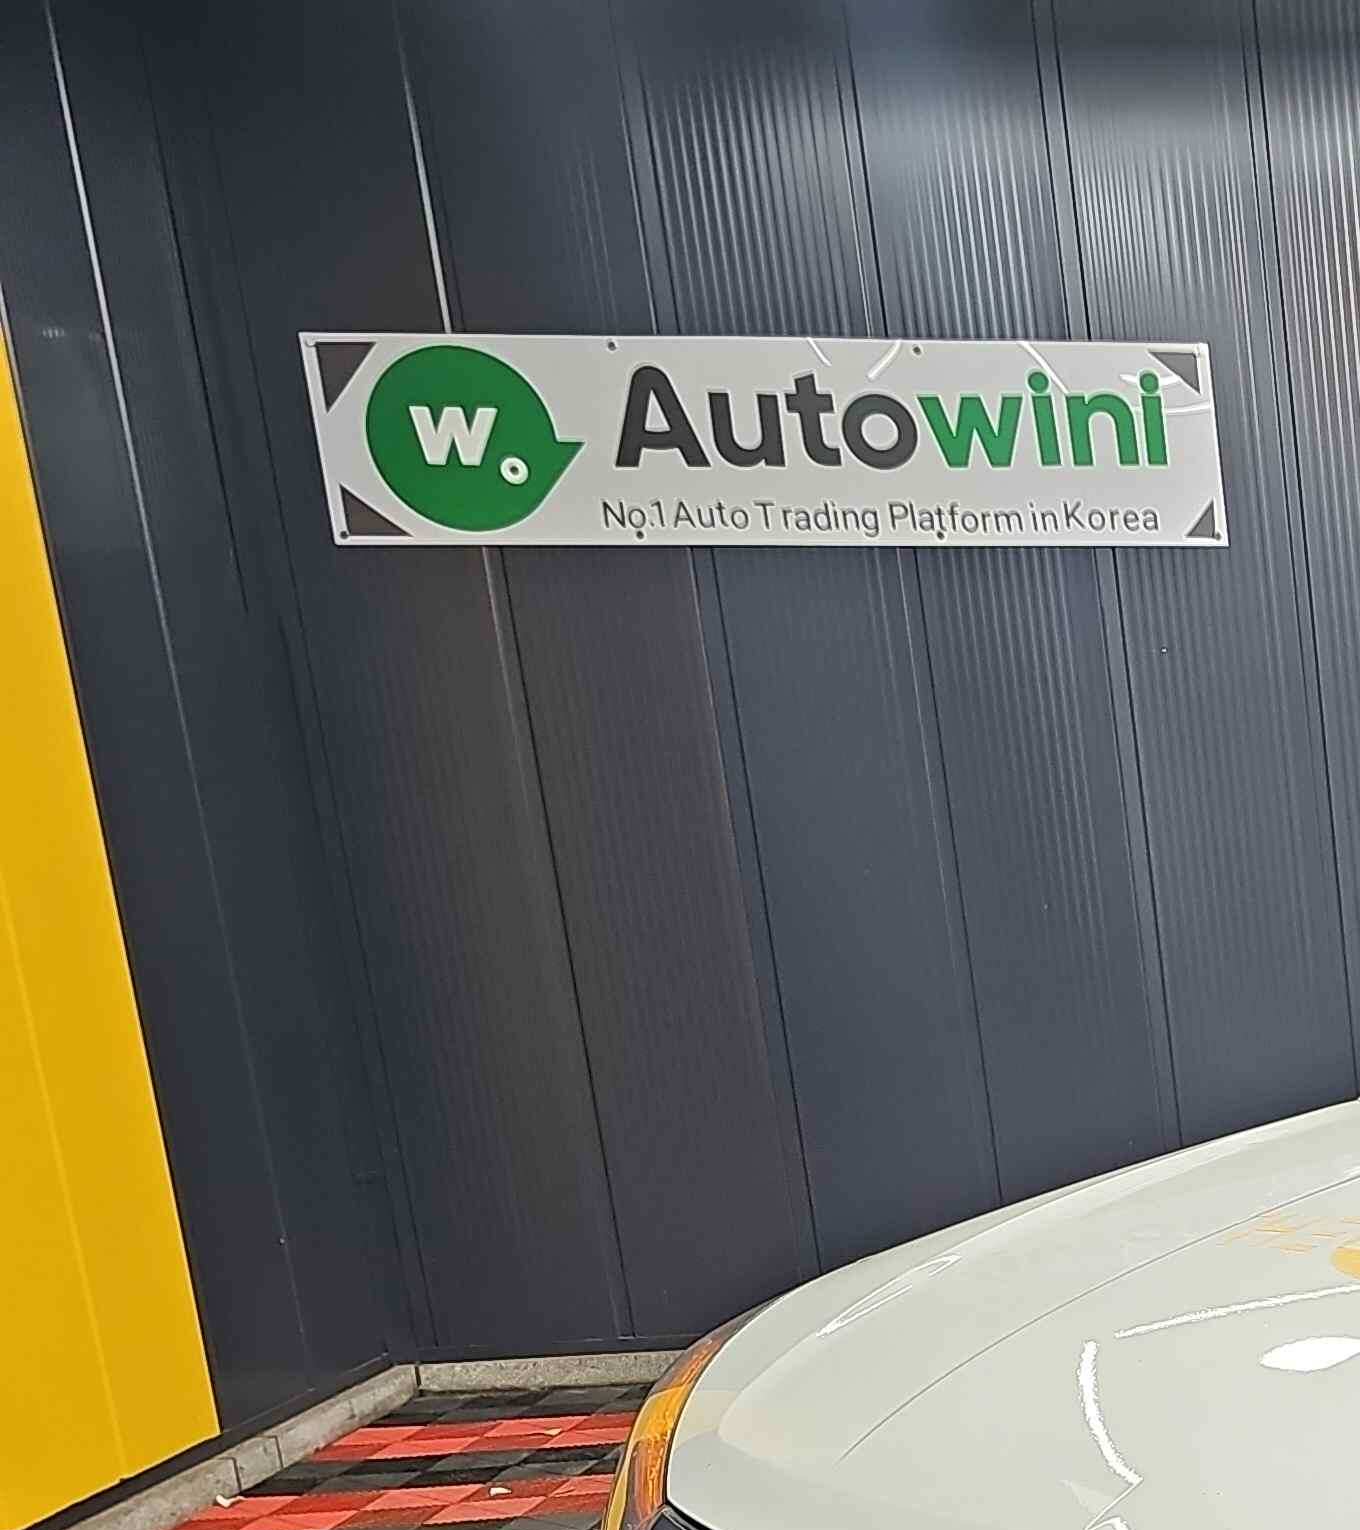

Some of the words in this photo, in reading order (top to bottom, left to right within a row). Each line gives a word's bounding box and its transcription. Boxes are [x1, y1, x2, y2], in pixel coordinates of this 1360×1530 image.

[615, 366, 1169, 469] Autowini
[602, 500, 666, 530] No.1
[674, 500, 749, 530] Auto
[754, 500, 880, 538] Trading
[888, 500, 1024, 533] Platform
[1029, 502, 1059, 533] in
[1062, 500, 1159, 531] Korea
